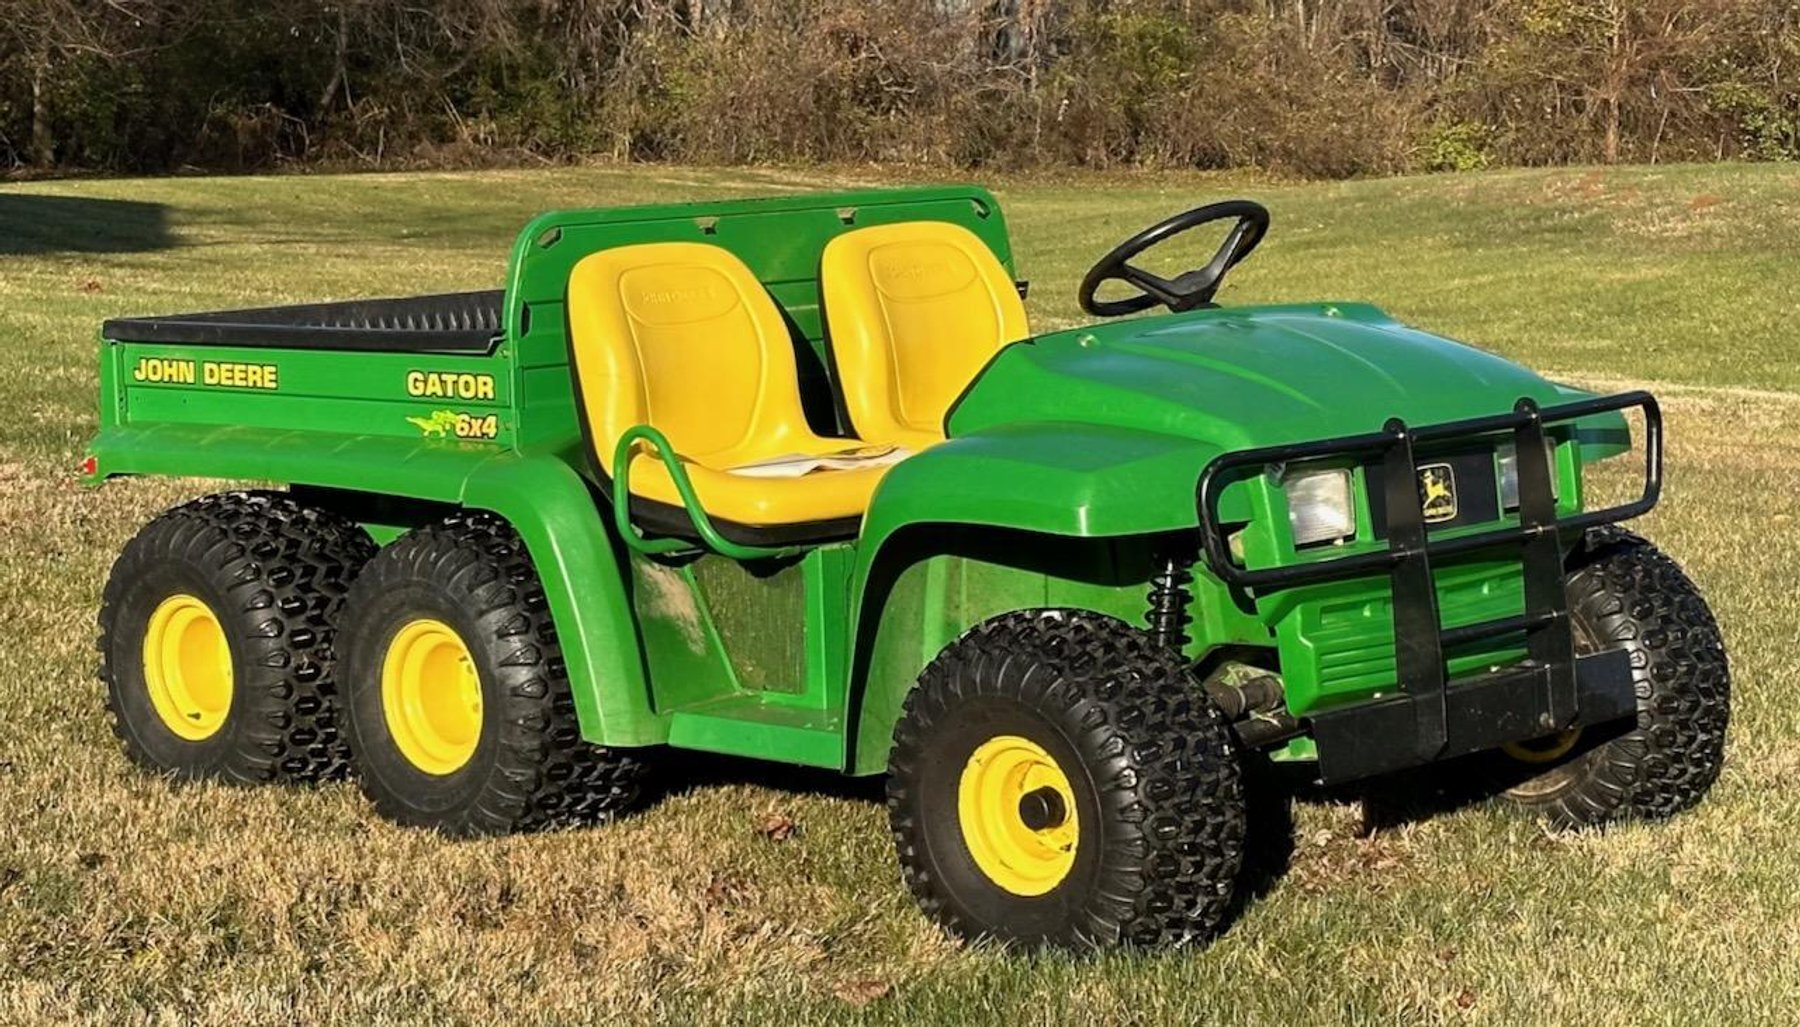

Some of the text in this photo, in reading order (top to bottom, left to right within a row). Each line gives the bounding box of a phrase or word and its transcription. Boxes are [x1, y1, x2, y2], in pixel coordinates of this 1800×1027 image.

[134, 358, 278, 389] JOHN DEERE
[407, 371, 495, 399] GATOR
[455, 413, 498, 438] 6x4
